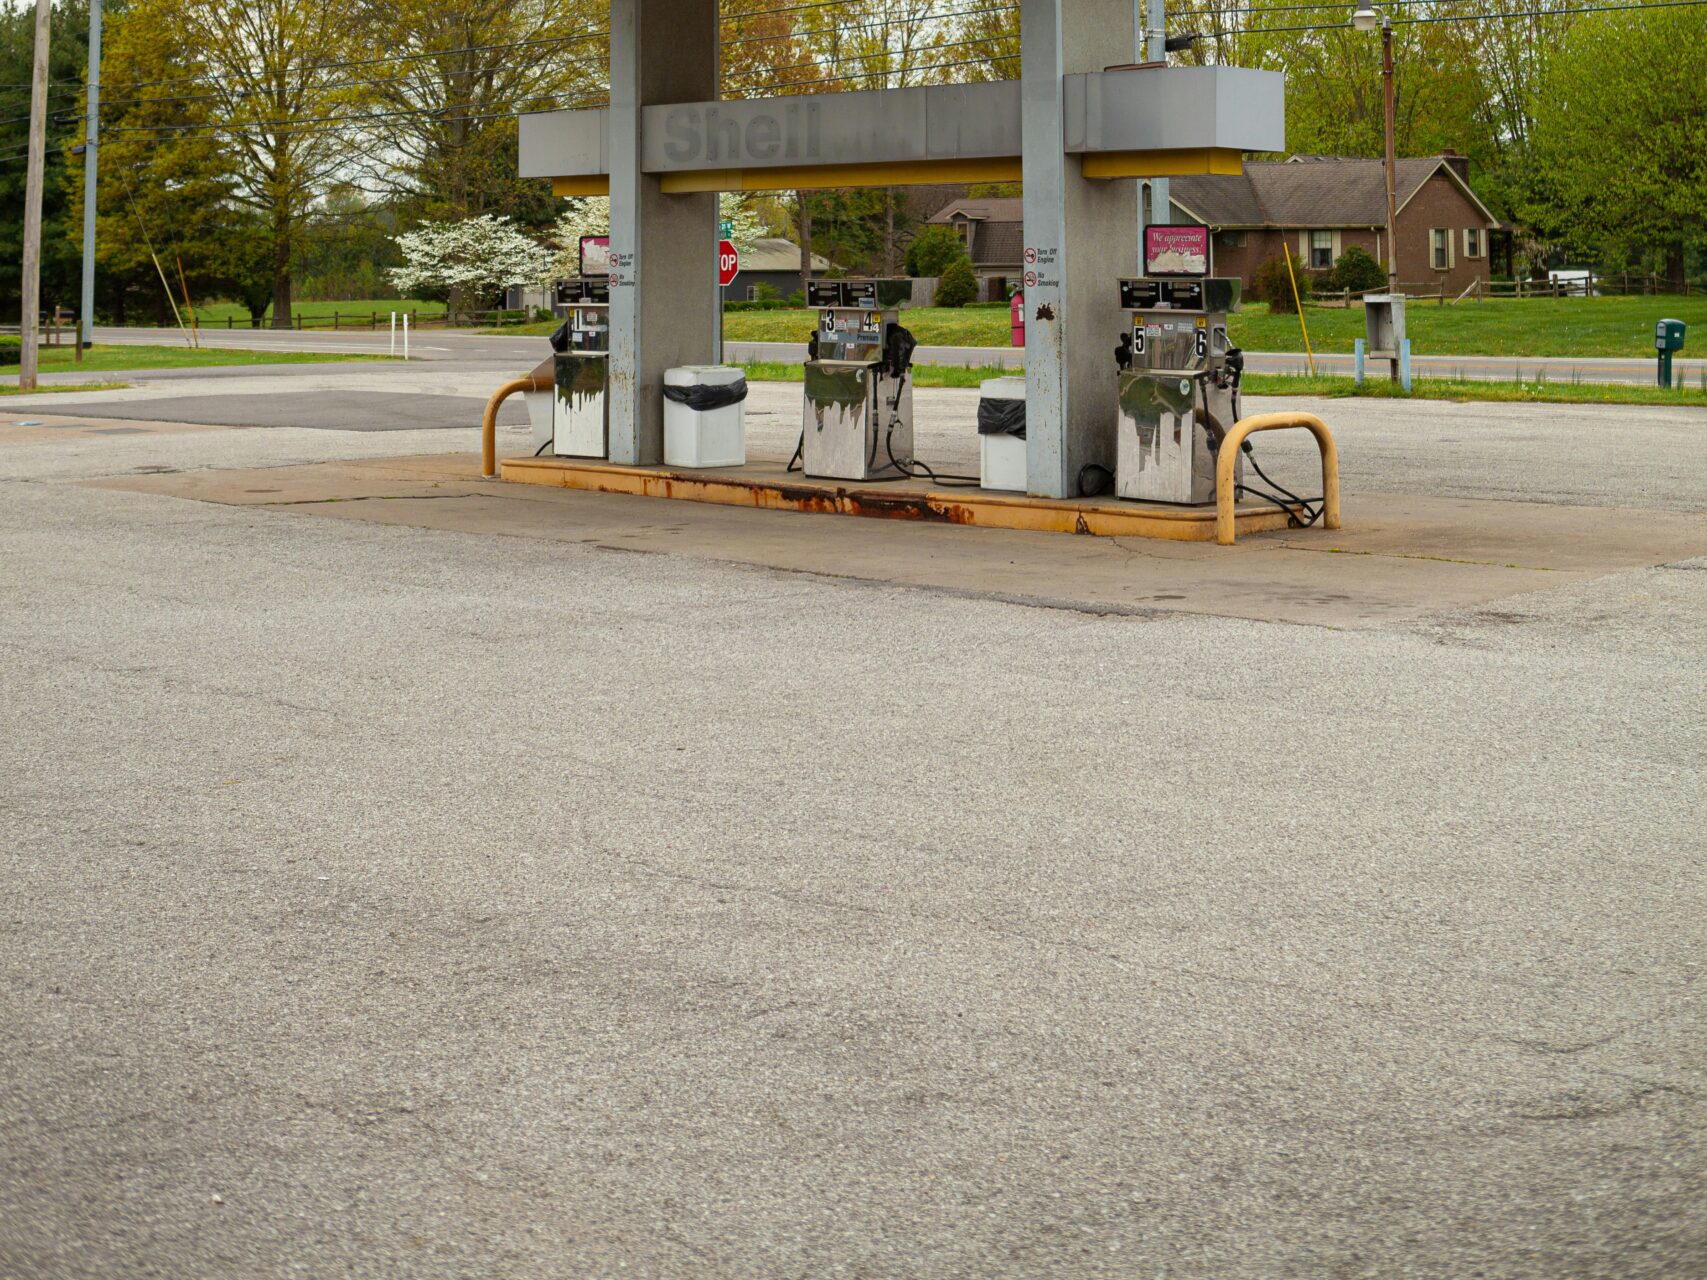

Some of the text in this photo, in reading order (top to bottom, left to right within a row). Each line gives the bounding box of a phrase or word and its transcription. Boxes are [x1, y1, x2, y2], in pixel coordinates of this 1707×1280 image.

[664, 102, 821, 162] Shell
[1152, 231, 1202, 244] We appreciate
[719, 254, 736, 271] OP
[1037, 256, 1054, 264] Engine
[1037, 280, 1059, 288] Smoking
[827, 310, 835, 331] 3
[864, 311, 872, 331] 4
[857, 332, 879, 342] Premium
[1135, 327, 1144, 352] 5
[1195, 330, 1206, 357] 6
